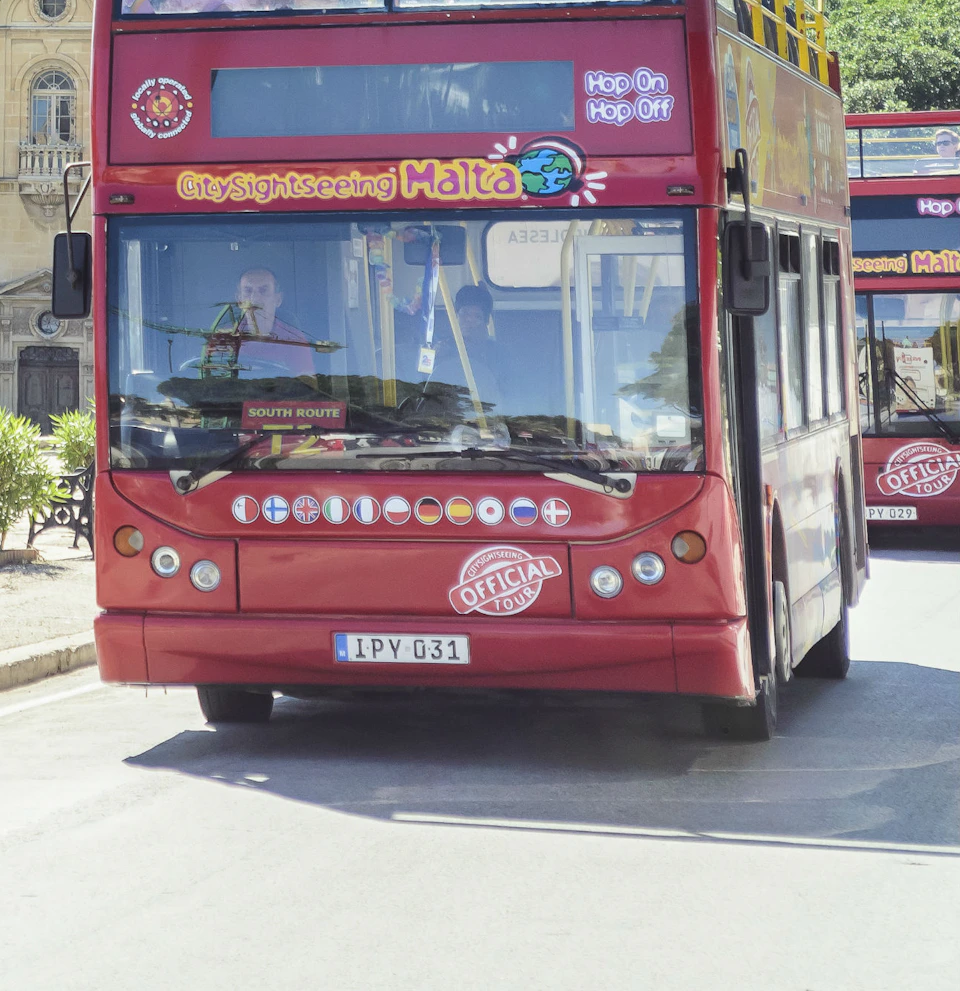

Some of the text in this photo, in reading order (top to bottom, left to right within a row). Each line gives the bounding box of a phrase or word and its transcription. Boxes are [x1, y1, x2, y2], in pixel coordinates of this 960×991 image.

[132, 77, 193, 101] locally operated
[586, 69, 666, 97] Hop On
[588, 96, 672, 124] Hop Off
[130, 110, 193, 139] globally connected
[179, 159, 519, 202] CitySightseeing Malta
[919, 199, 954, 216] Hop
[248, 408, 340, 418] SOUTH ROUTE
[916, 475, 952, 494] TOUR
[868, 508, 913, 519] PY 029
[467, 551, 524, 577] CITYSIGHTSEEING
[460, 560, 555, 606] OFFICIAL
[494, 586, 536, 611] TOUR
[356, 638, 460, 660] IPY 031
